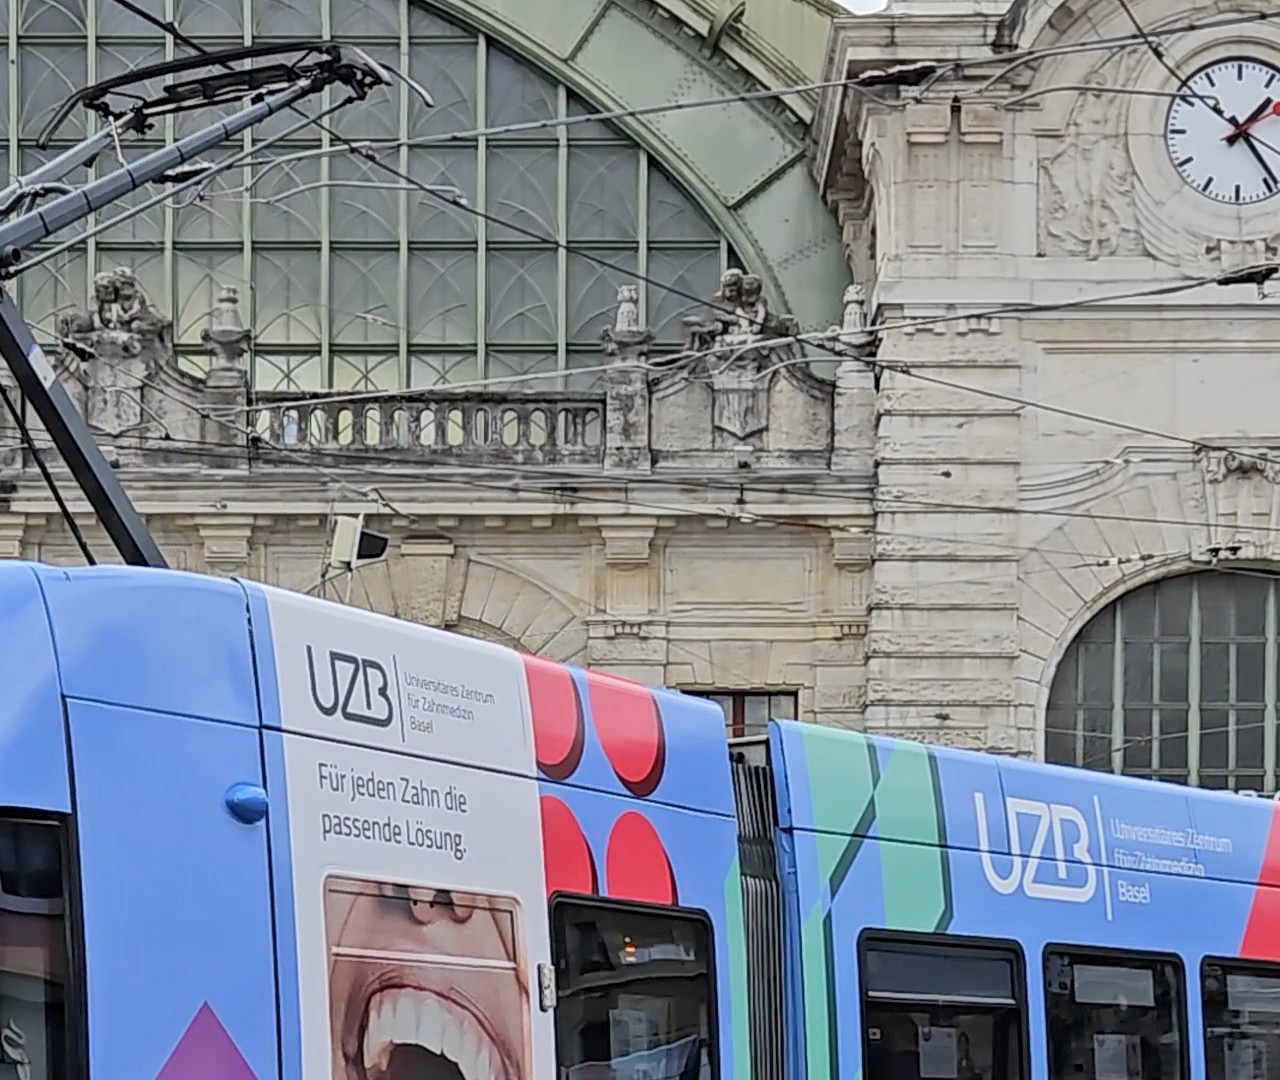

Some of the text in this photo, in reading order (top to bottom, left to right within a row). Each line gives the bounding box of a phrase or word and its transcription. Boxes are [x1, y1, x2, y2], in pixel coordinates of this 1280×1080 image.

[306, 645, 394, 728] UZB
[460, 684, 495, 704] Zentrum
[410, 716, 433, 733] Basel
[317, 762, 468, 813] Für jeden Zahn die
[322, 812, 467, 861] passende Lösung.
[974, 791, 1097, 903] UZB
[1118, 880, 1150, 903] Basel
